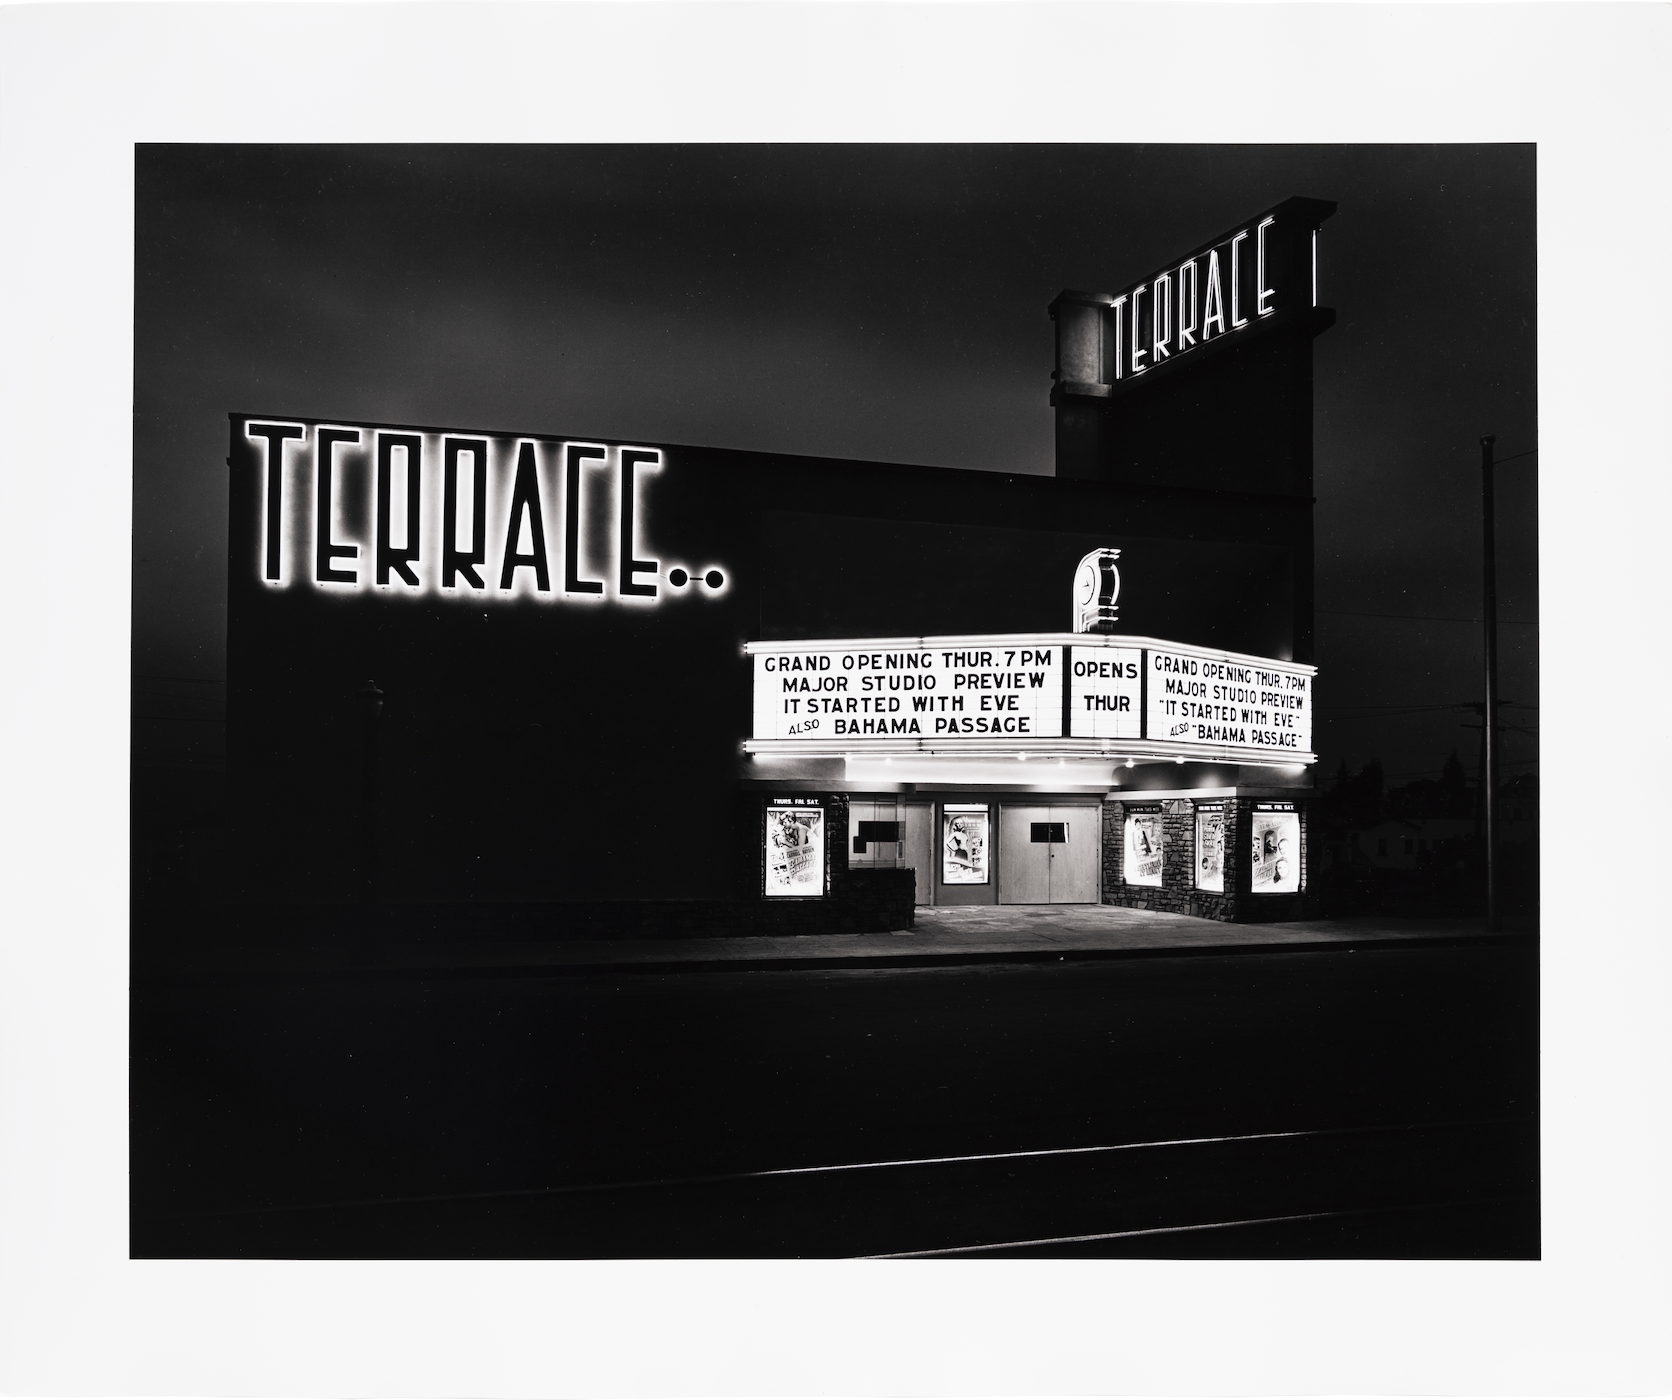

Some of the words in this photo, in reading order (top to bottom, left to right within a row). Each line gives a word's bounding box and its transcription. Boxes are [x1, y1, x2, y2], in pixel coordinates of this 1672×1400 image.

[1110, 215, 1275, 379] TERRACE
[247, 422, 659, 597] TERRACE
[764, 655, 831, 672] GRAND
[842, 652, 932, 671] OPENING
[941, 651, 1000, 669] THUR.
[1073, 661, 1138, 679] OPENS
[1155, 655, 1198, 676] GRAND
[1202, 662, 1251, 684] OPENING
[1255, 671, 1283, 689] THUR.
[782, 676, 848, 693] MAJOR
[861, 674, 937, 692] STUDIO
[954, 671, 1045, 690] PREVIEW
[784, 698, 801, 714] IT
[807, 696, 900, 714] STARTED
[912, 695, 964, 712] WITH
[980, 694, 1020, 711] EVE
[1083, 694, 1131, 712] THUR
[1165, 677, 1207, 699] MAJOR
[1261, 691, 1304, 710] PREVIEW
[1181, 701, 1237, 722] STARTED
[1241, 708, 1267, 725] WITH
[788, 718, 820, 735] ALSO
[834, 717, 921, 735] BAHAMA
[935, 716, 1030, 734] PASSAGE
[1169, 722, 1190, 737] ALSO
